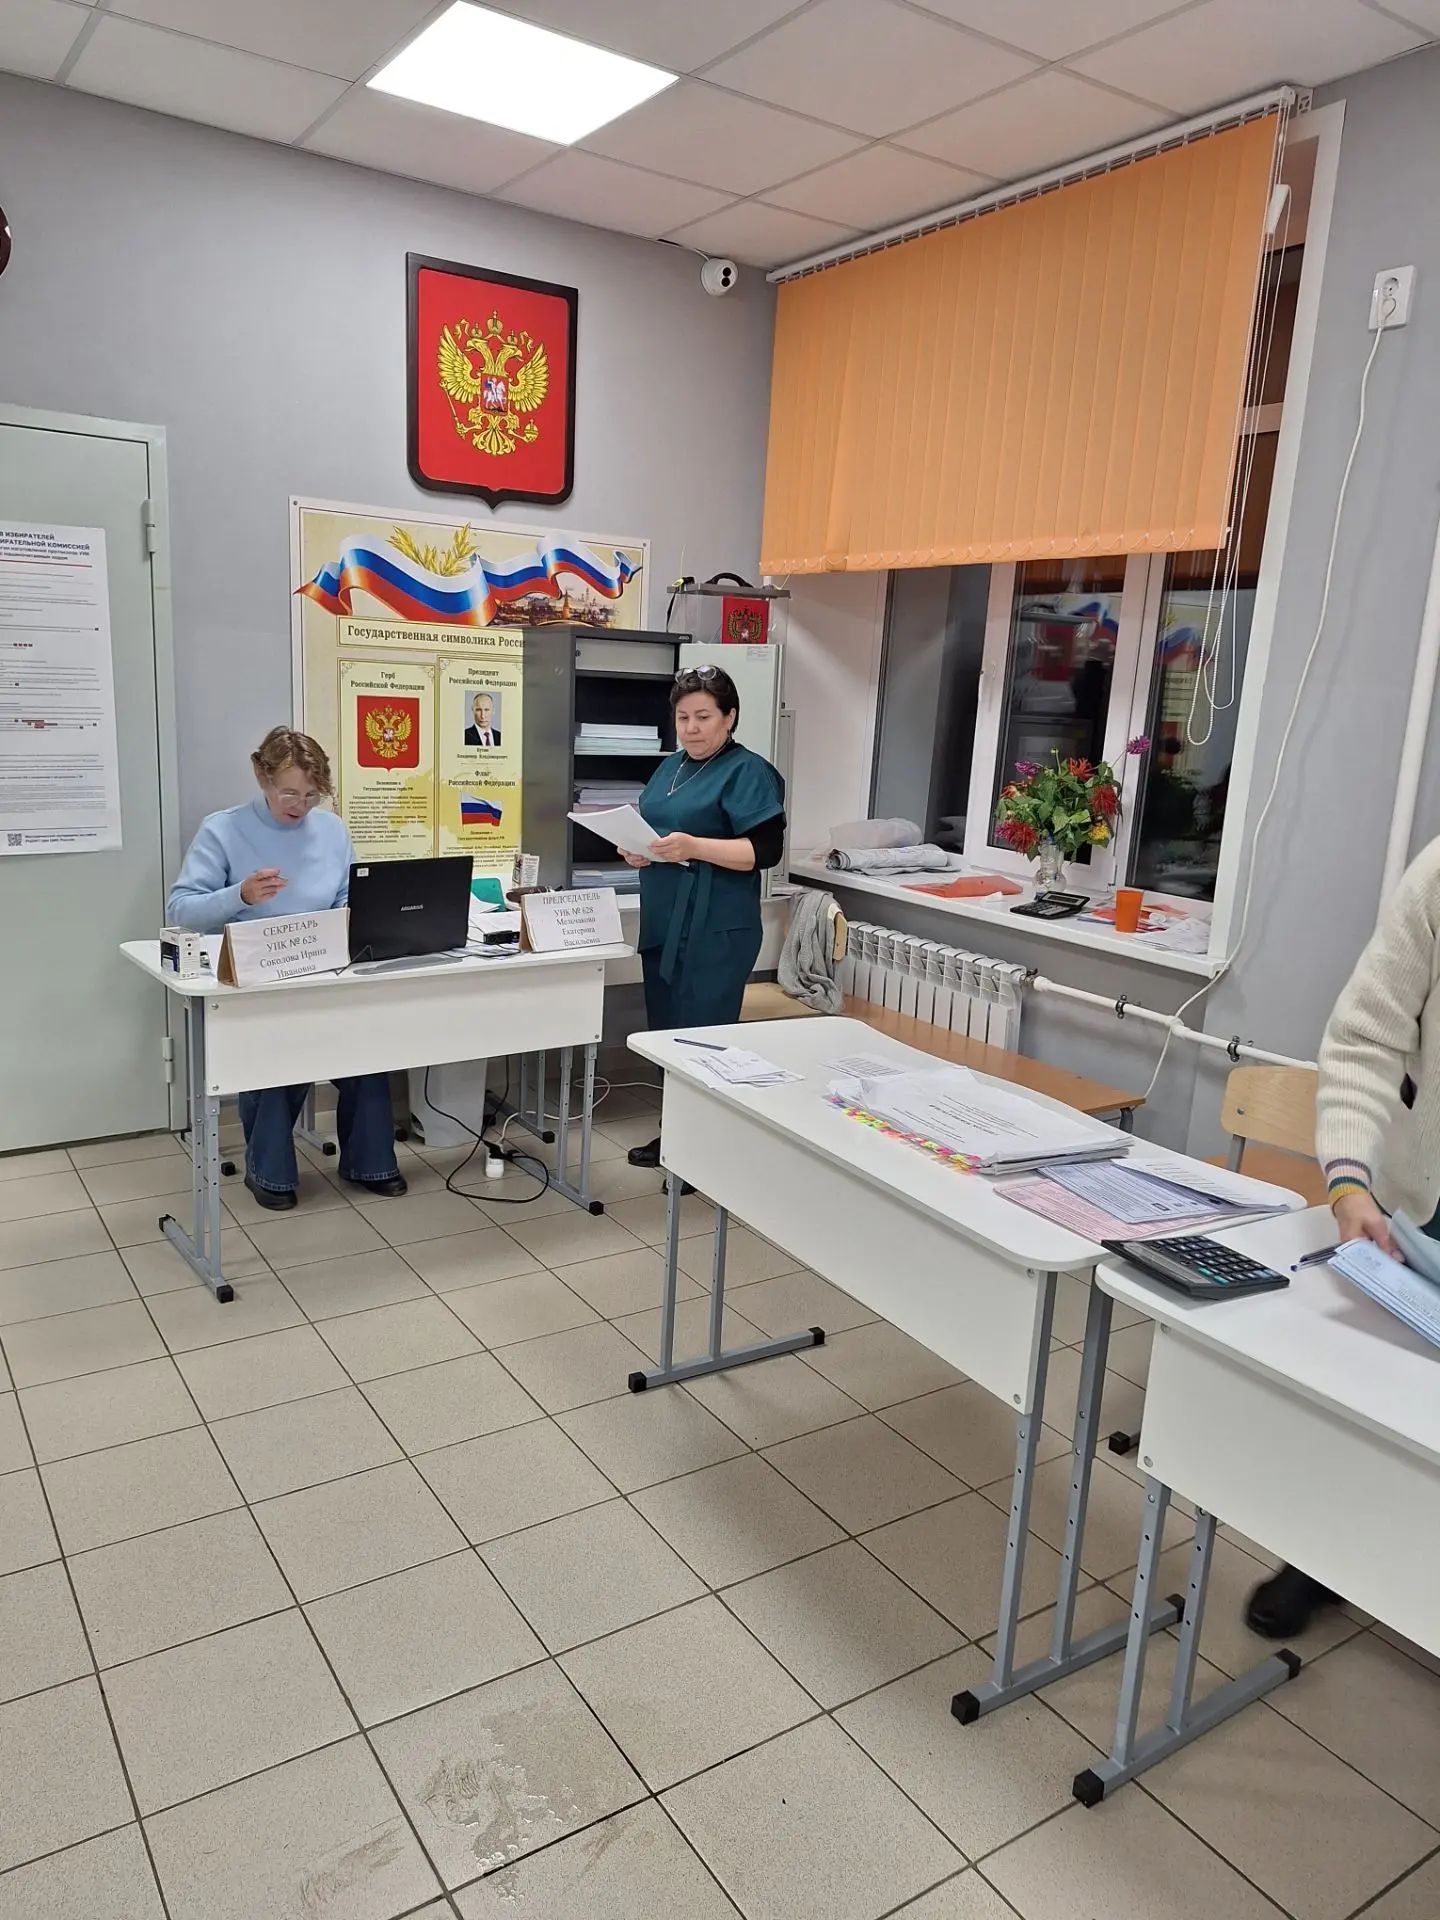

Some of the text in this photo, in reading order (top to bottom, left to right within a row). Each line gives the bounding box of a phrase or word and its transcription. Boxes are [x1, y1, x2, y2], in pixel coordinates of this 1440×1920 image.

[5, 531, 55, 540] ИЗБИРАТЕЛЕЙ
[47, 542, 90, 550] КОМИССИЕЙ
[347, 625, 439, 642] Государственная
[441, 635, 496, 646] символика
[381, 671, 396, 680] Герб
[468, 667, 499, 677] Президент
[350, 680, 425, 691] Российской Федерации
[448, 677, 518, 688] Российской Федерации
[483, 779, 516, 787] Федерации
[542, 892, 601, 905] ПРЕДСЕДАТЕЛЬ
[553, 906, 594, 918] УИК № 628
[263, 919, 318, 937] СЕКРЕТАРЬ
[562, 927, 596, 936] Екатерина
[266, 935, 317, 952] УИК № 628
[259, 947, 327, 968] Соколова Ирина
[276, 964, 317, 978] Ивановна
